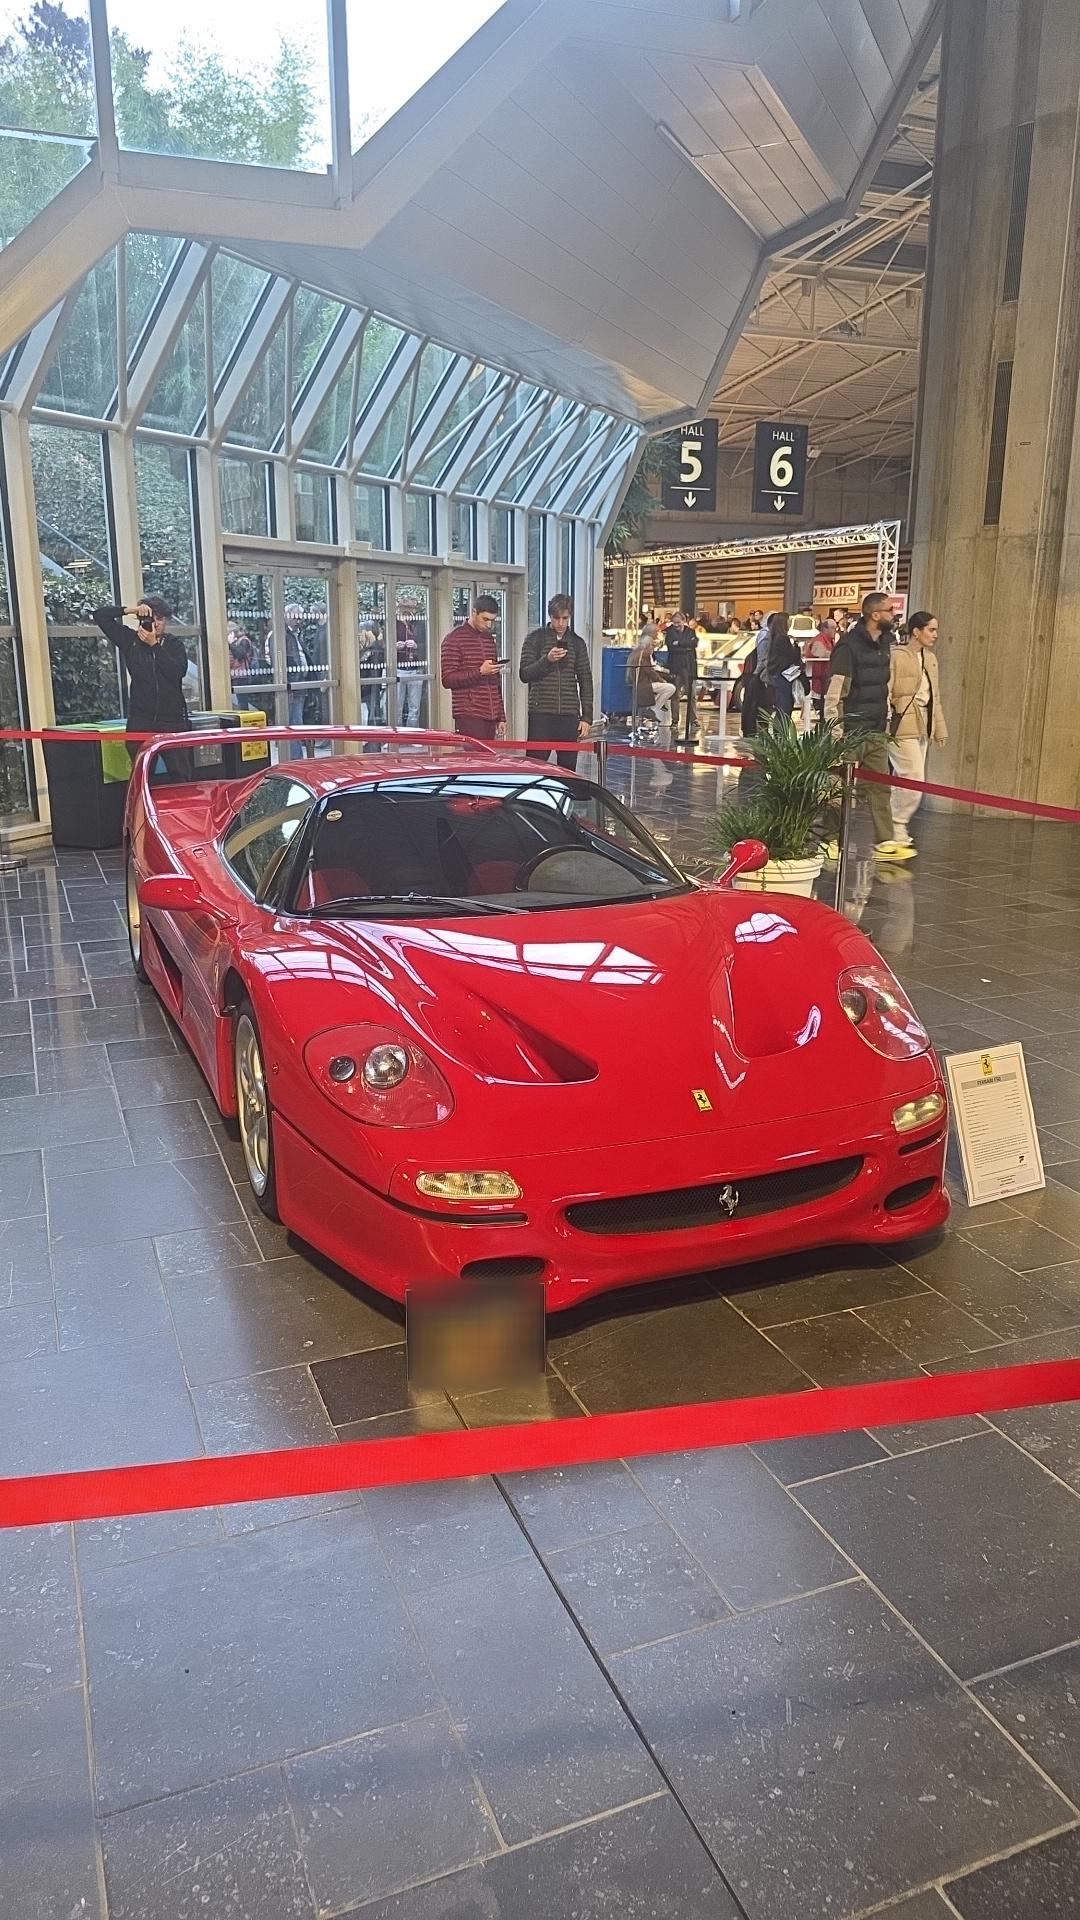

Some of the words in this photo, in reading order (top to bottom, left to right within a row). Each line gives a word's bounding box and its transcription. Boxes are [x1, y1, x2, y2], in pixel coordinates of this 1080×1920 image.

[680, 426, 705, 437] HALL
[772, 430, 795, 442] HALL
[680, 440, 702, 483] 5
[769, 446, 794, 487] 6
[820, 585, 856, 598] FOLIES
